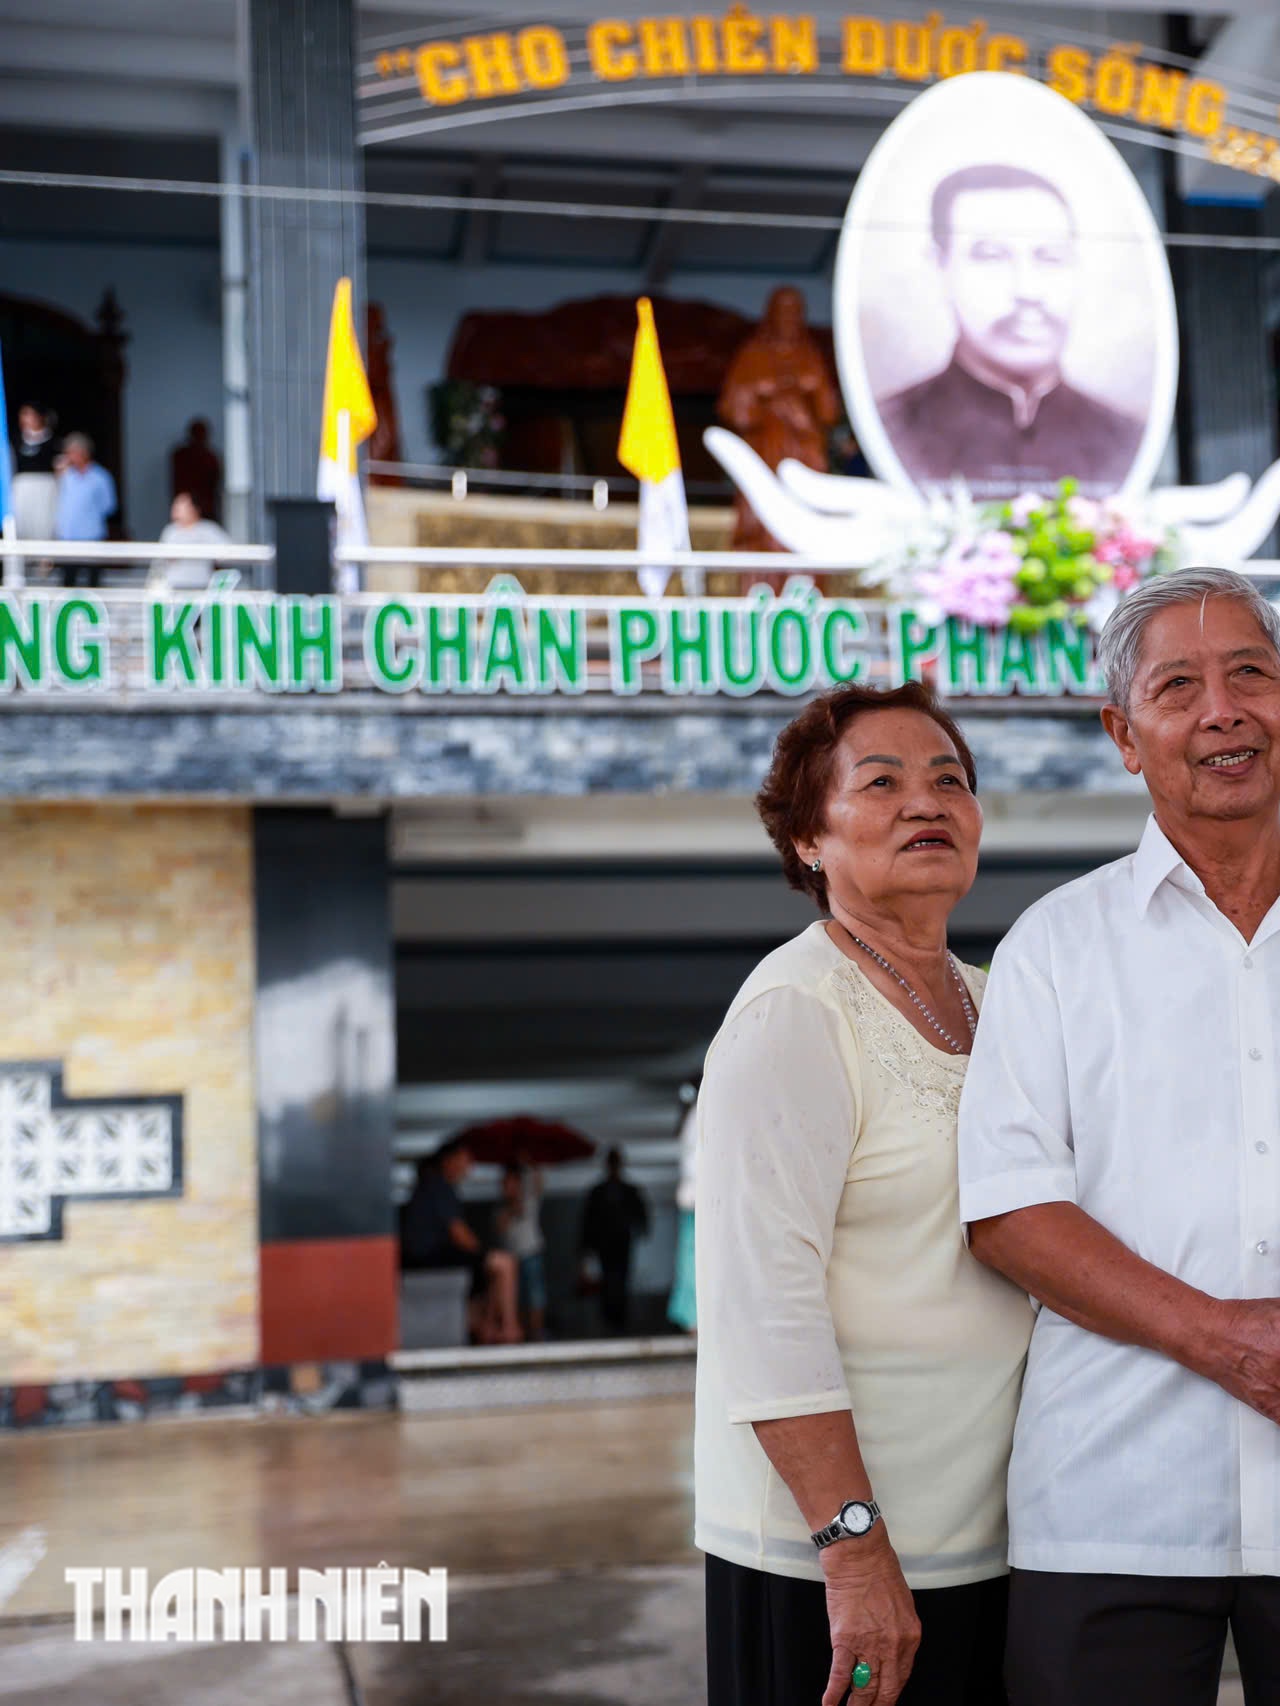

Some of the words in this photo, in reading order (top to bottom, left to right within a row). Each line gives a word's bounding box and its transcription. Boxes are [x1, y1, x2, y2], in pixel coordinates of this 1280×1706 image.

[588, 3, 818, 83] CHIÊN
[151, 572, 334, 684] KÍNH
[373, 577, 578, 684] CHÂN
[619, 580, 862, 686] PHƯỚC
[900, 610, 1104, 687] PHAN
